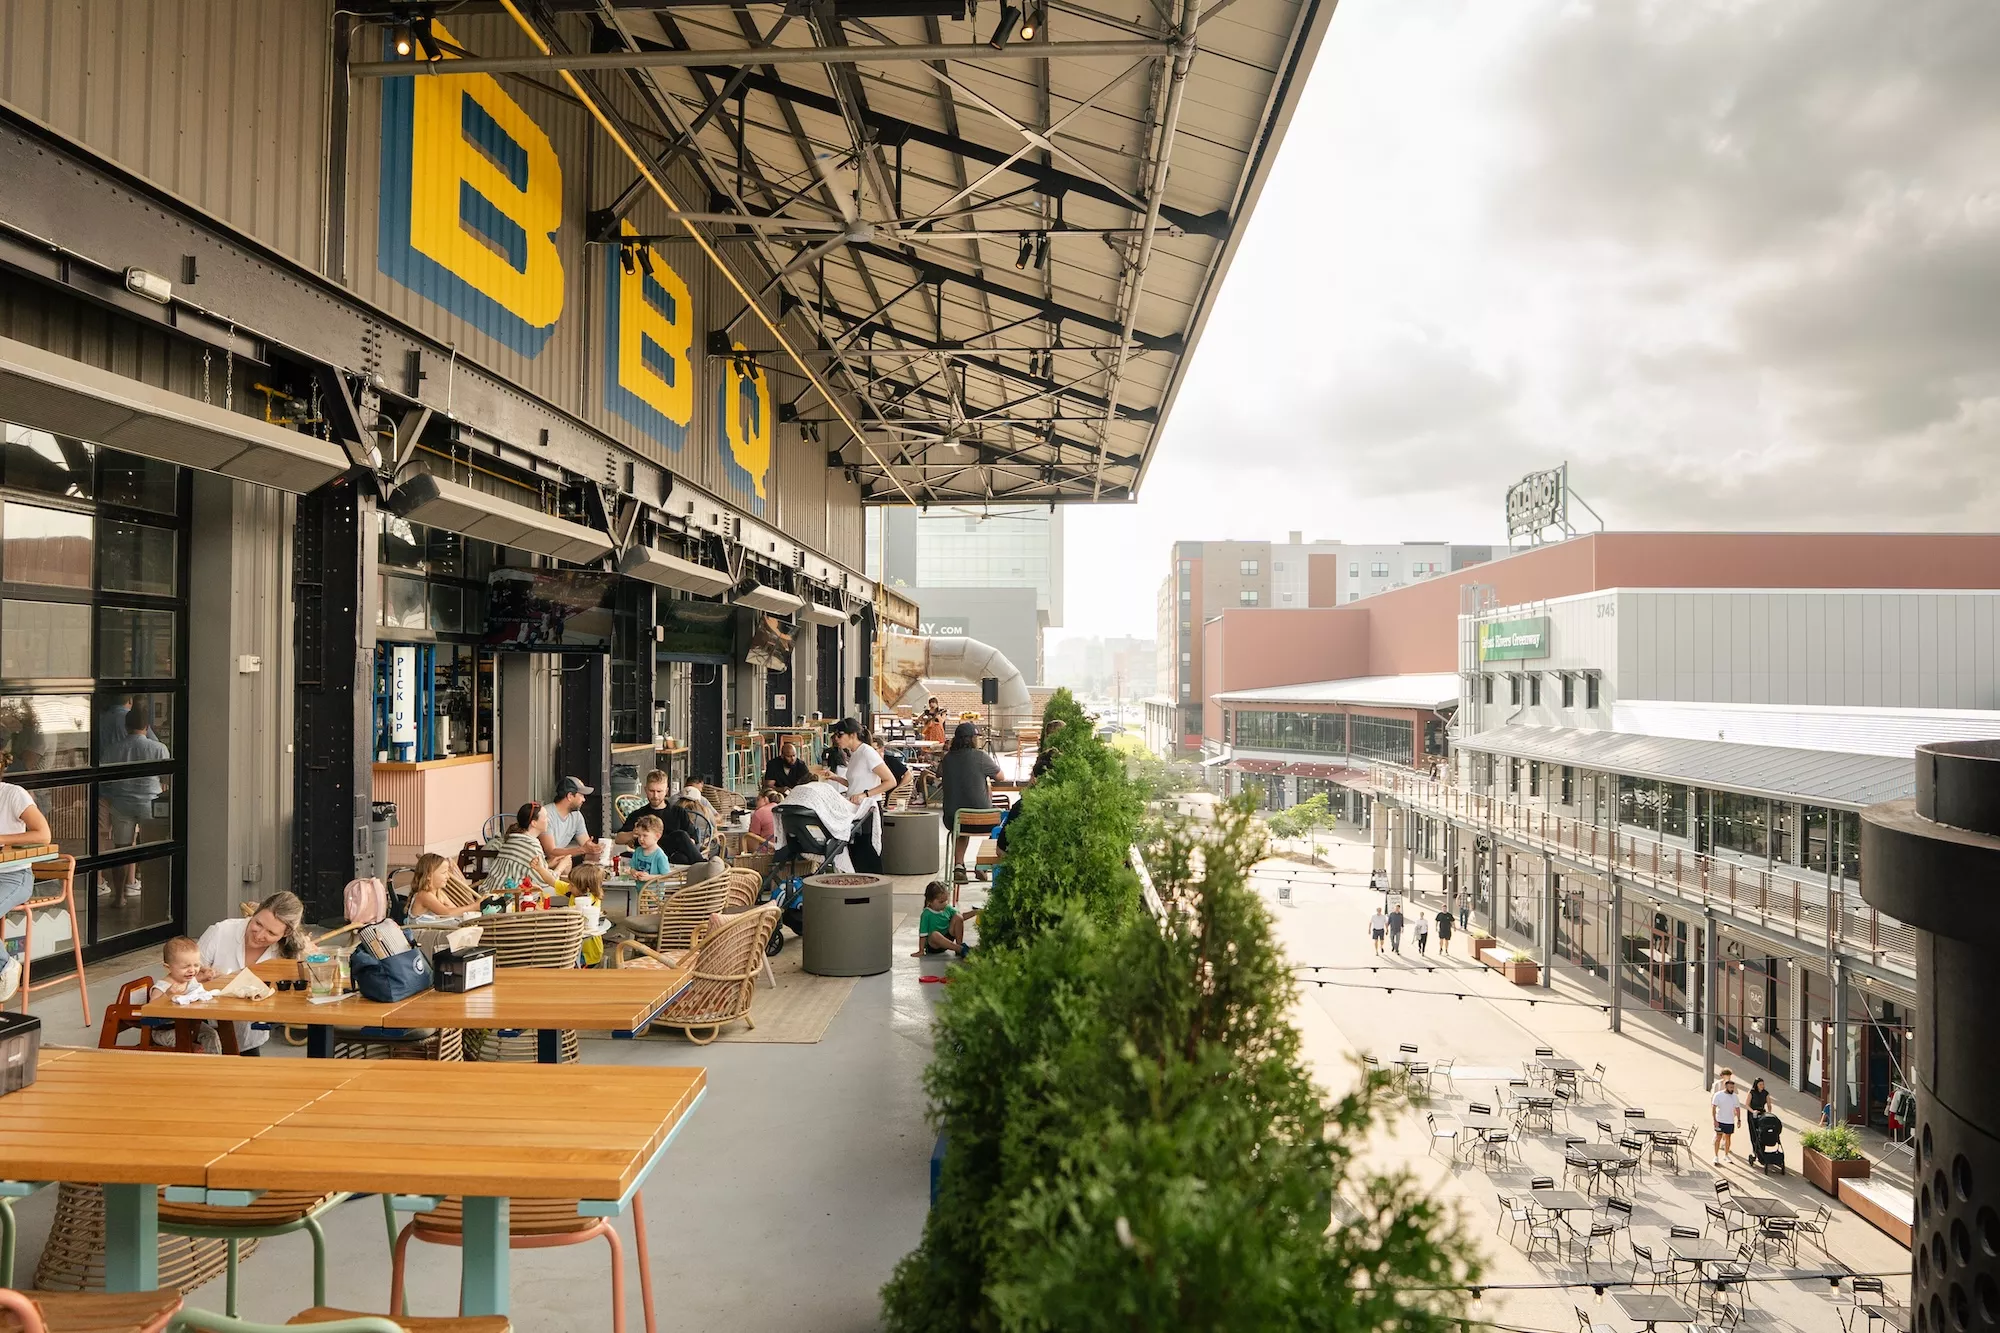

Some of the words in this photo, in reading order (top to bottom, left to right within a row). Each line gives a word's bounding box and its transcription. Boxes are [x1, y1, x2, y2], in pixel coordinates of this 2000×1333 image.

[379, 17, 771, 518] BBQ
[1509, 474, 1552, 517] ALAMO
[1596, 602, 1615, 619] 3745
[1495, 634, 1511, 648] Rivers
[1512, 633, 1541, 648] Greenway
[396, 712, 403, 732] UP
